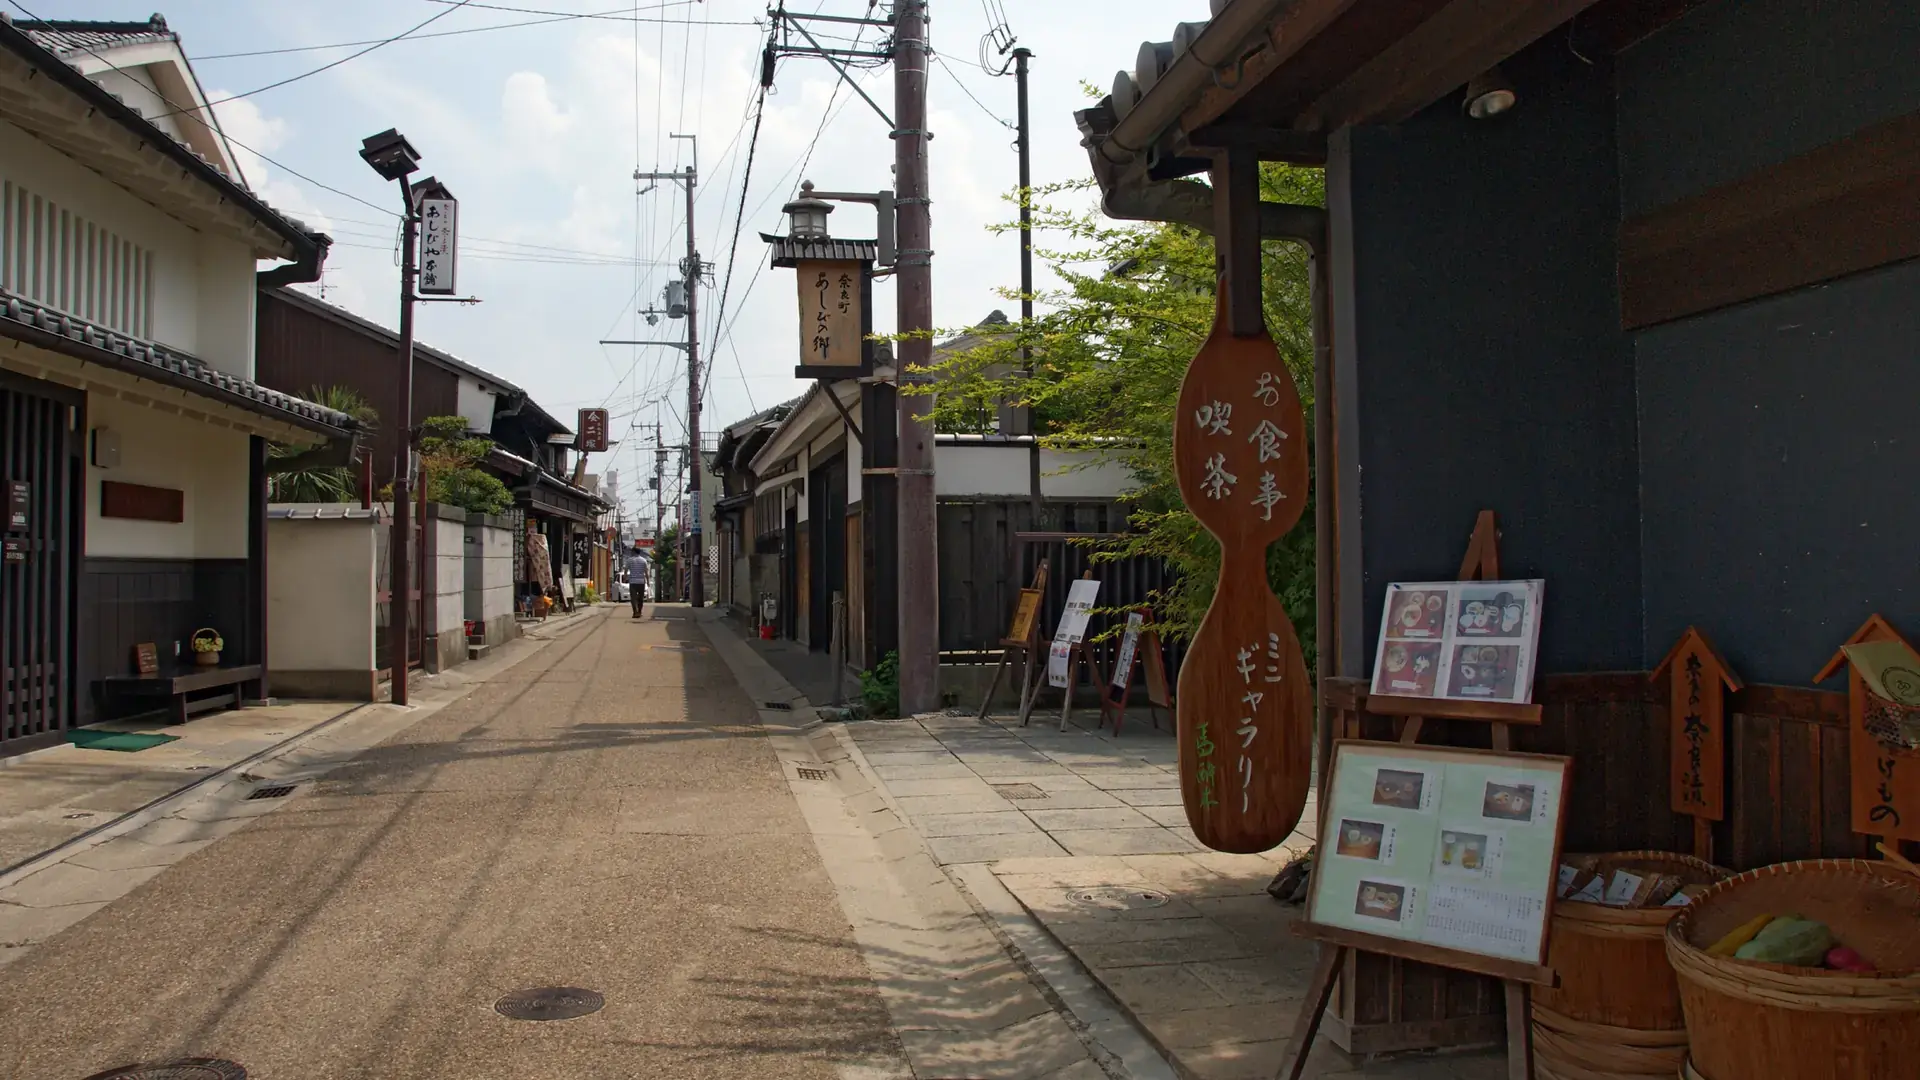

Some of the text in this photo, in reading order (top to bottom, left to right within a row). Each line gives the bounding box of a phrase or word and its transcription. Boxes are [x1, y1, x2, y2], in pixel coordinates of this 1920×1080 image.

[424, 206, 440, 286] あしびや本舗
[813, 272, 831, 360] あしびの郷
[838, 273, 852, 313] 奈良町
[1196, 400, 1238, 500] 喫茶
[1248, 372, 1289, 521] お食事
[1265, 633, 1282, 683] ミニ
[1236, 642, 1264, 814] ギャラリー
